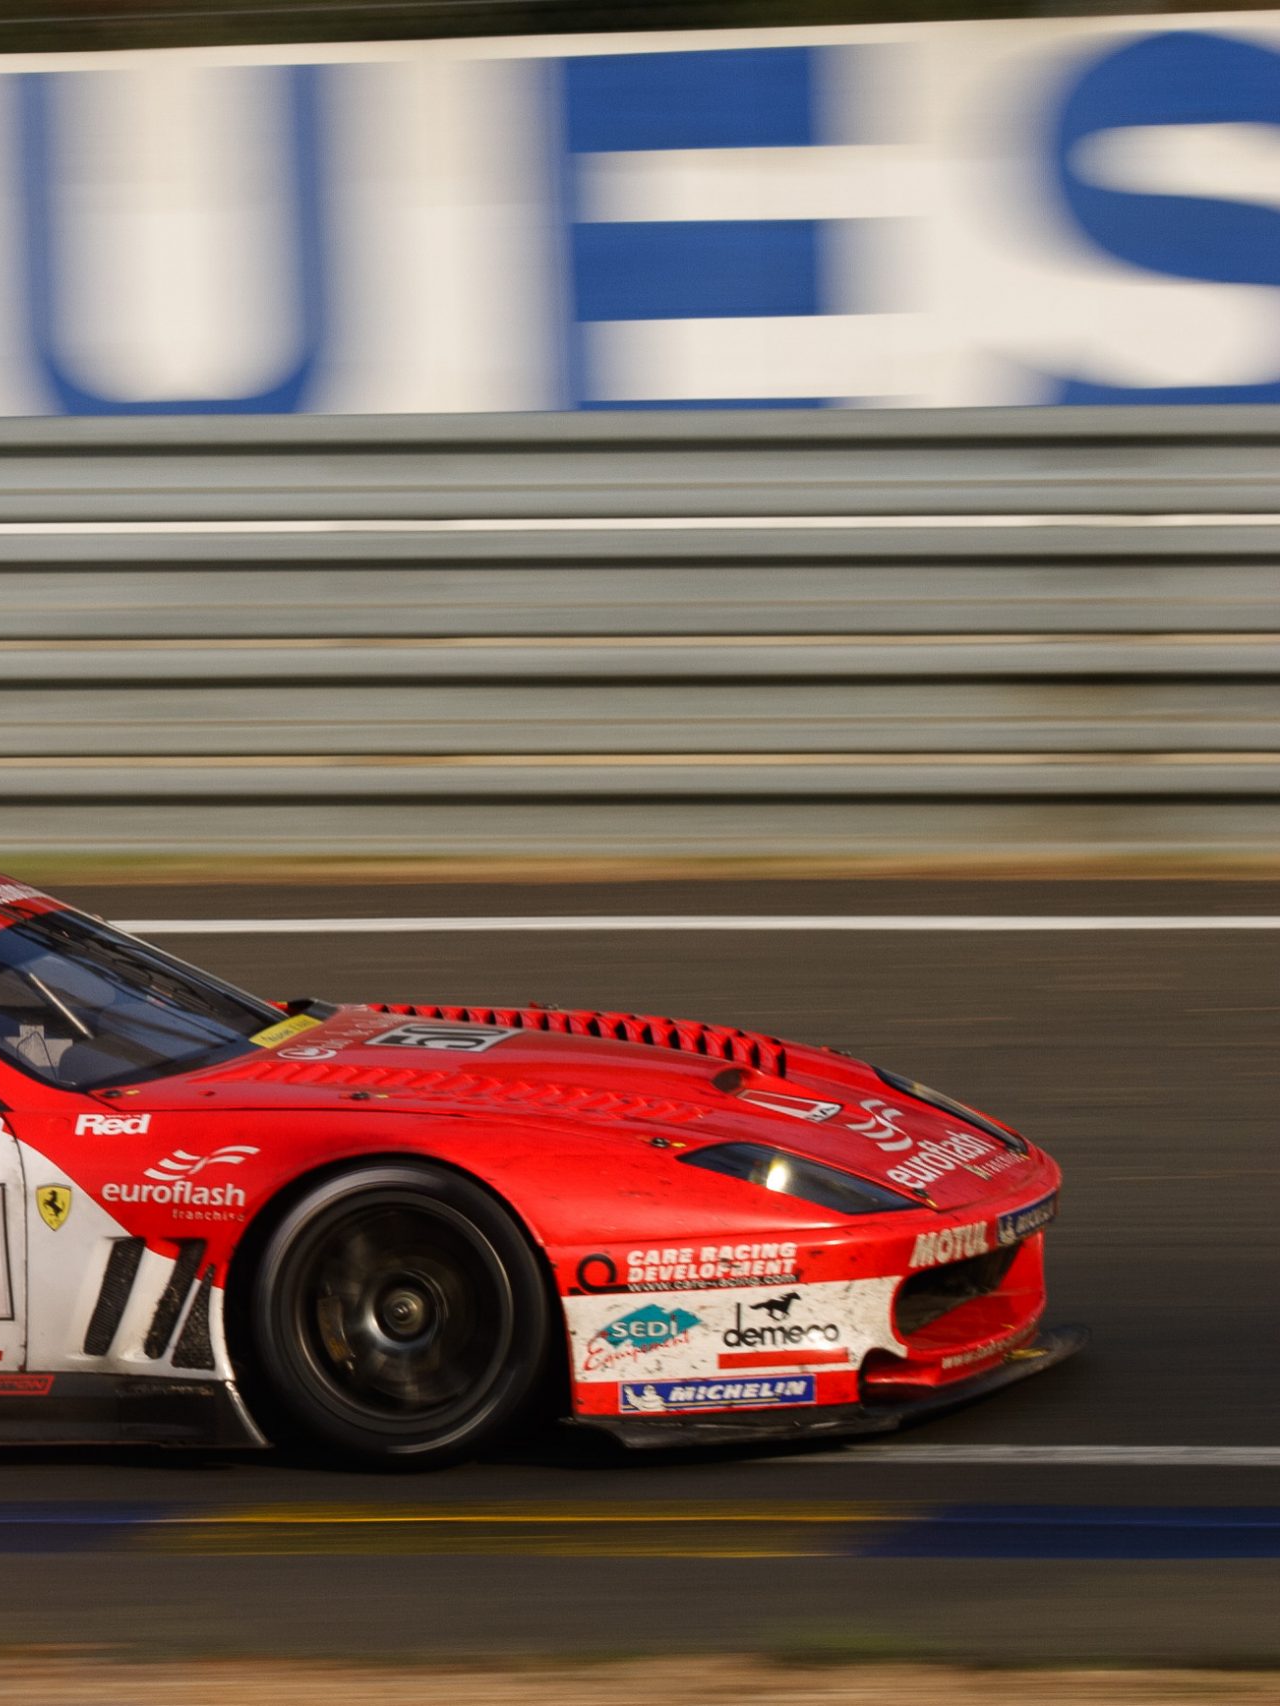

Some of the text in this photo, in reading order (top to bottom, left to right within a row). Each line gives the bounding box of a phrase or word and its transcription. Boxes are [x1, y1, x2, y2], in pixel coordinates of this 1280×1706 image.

[377, 1025, 509, 1049] 50
[74, 1112, 153, 1136] Red
[886, 1130, 998, 1190] euroflash
[101, 1180, 246, 1207] euroflash
[171, 1208, 246, 1223] franchise
[626, 1241, 798, 1267] CARE RACING
[908, 1220, 990, 1268] MOTUL
[627, 1258, 798, 1283] DEVELOPMENT
[722, 1302, 840, 1348] demeco
[669, 1380, 807, 1402] MICHELIN
